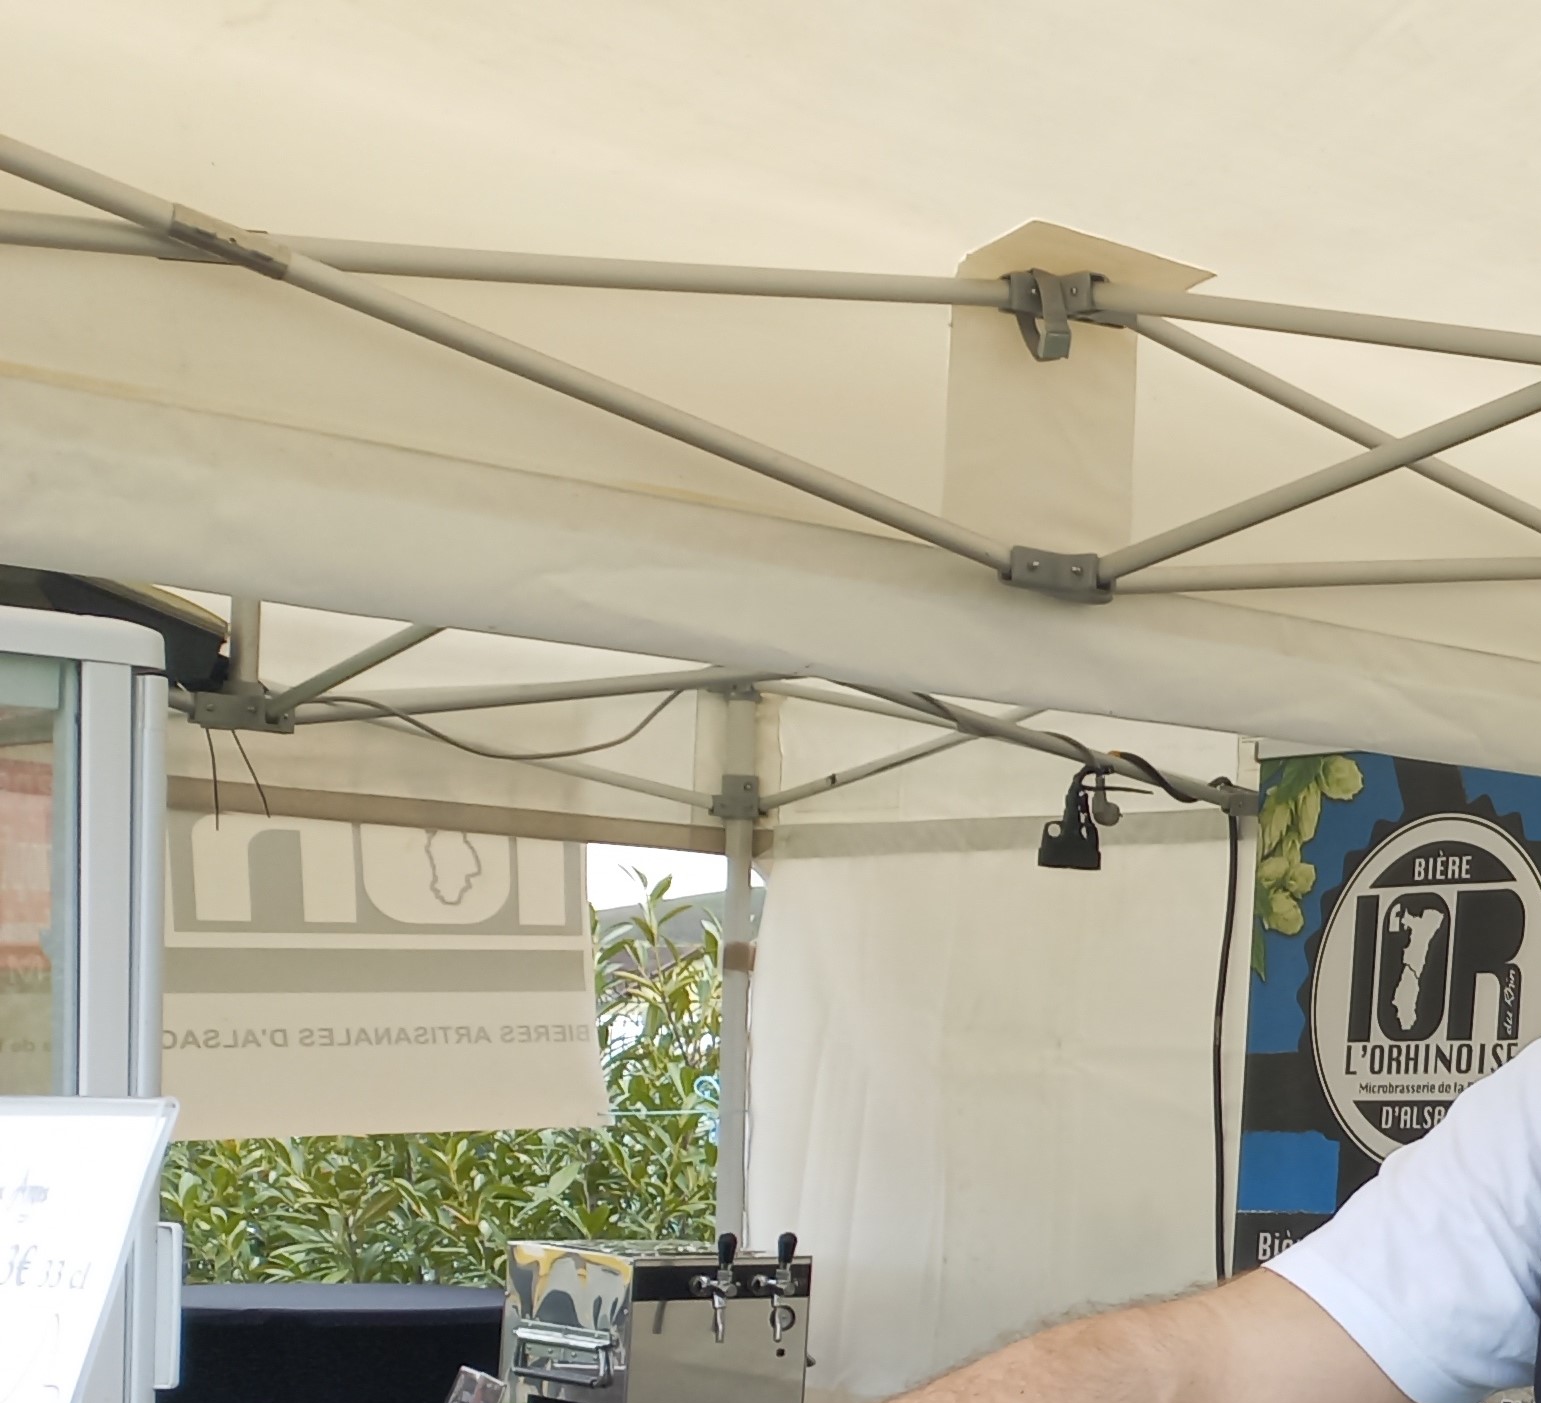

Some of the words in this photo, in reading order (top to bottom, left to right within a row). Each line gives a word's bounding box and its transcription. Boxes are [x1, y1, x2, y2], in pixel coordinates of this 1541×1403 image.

[1413, 850, 1472, 881] BIÈRE
[1345, 1043, 1518, 1075] L'ORHINOISE
[1359, 1082, 1435, 1094] Microbrasserie
[1438, 1083, 1450, 1094] de
[1381, 1106, 1446, 1129] D'ALSA
